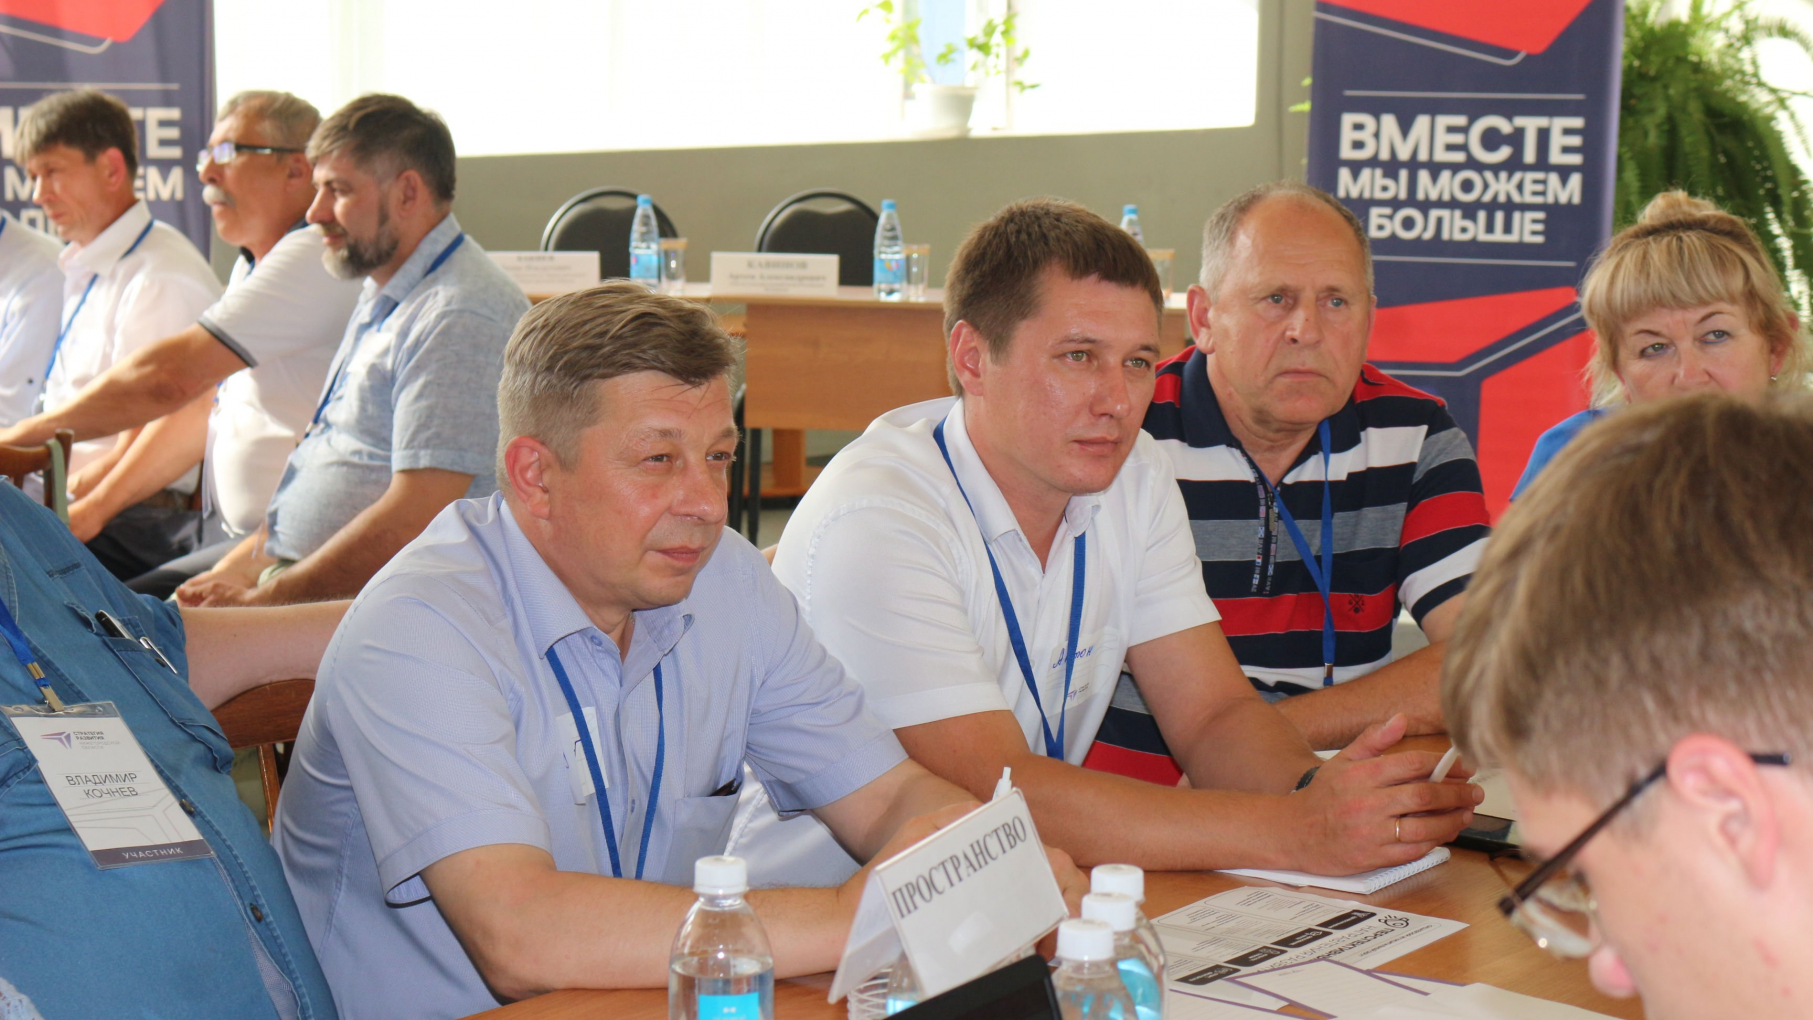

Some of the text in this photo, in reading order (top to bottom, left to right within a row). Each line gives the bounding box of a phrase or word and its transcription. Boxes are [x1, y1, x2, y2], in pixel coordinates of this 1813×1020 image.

[1339, 112, 1585, 165] ВМЕСТЕ
[1337, 167, 1583, 205] МЫ МОЖЕМ
[1367, 206, 1547, 243] БОЛЬШЕ
[65, 772, 137, 786] ВЛАДИМИР
[83, 786, 139, 799] КОЧНЕВ
[122, 847, 184, 859] УЧАСТНИК
[891, 816, 1027, 919] ПРОСТРАНСТВО
